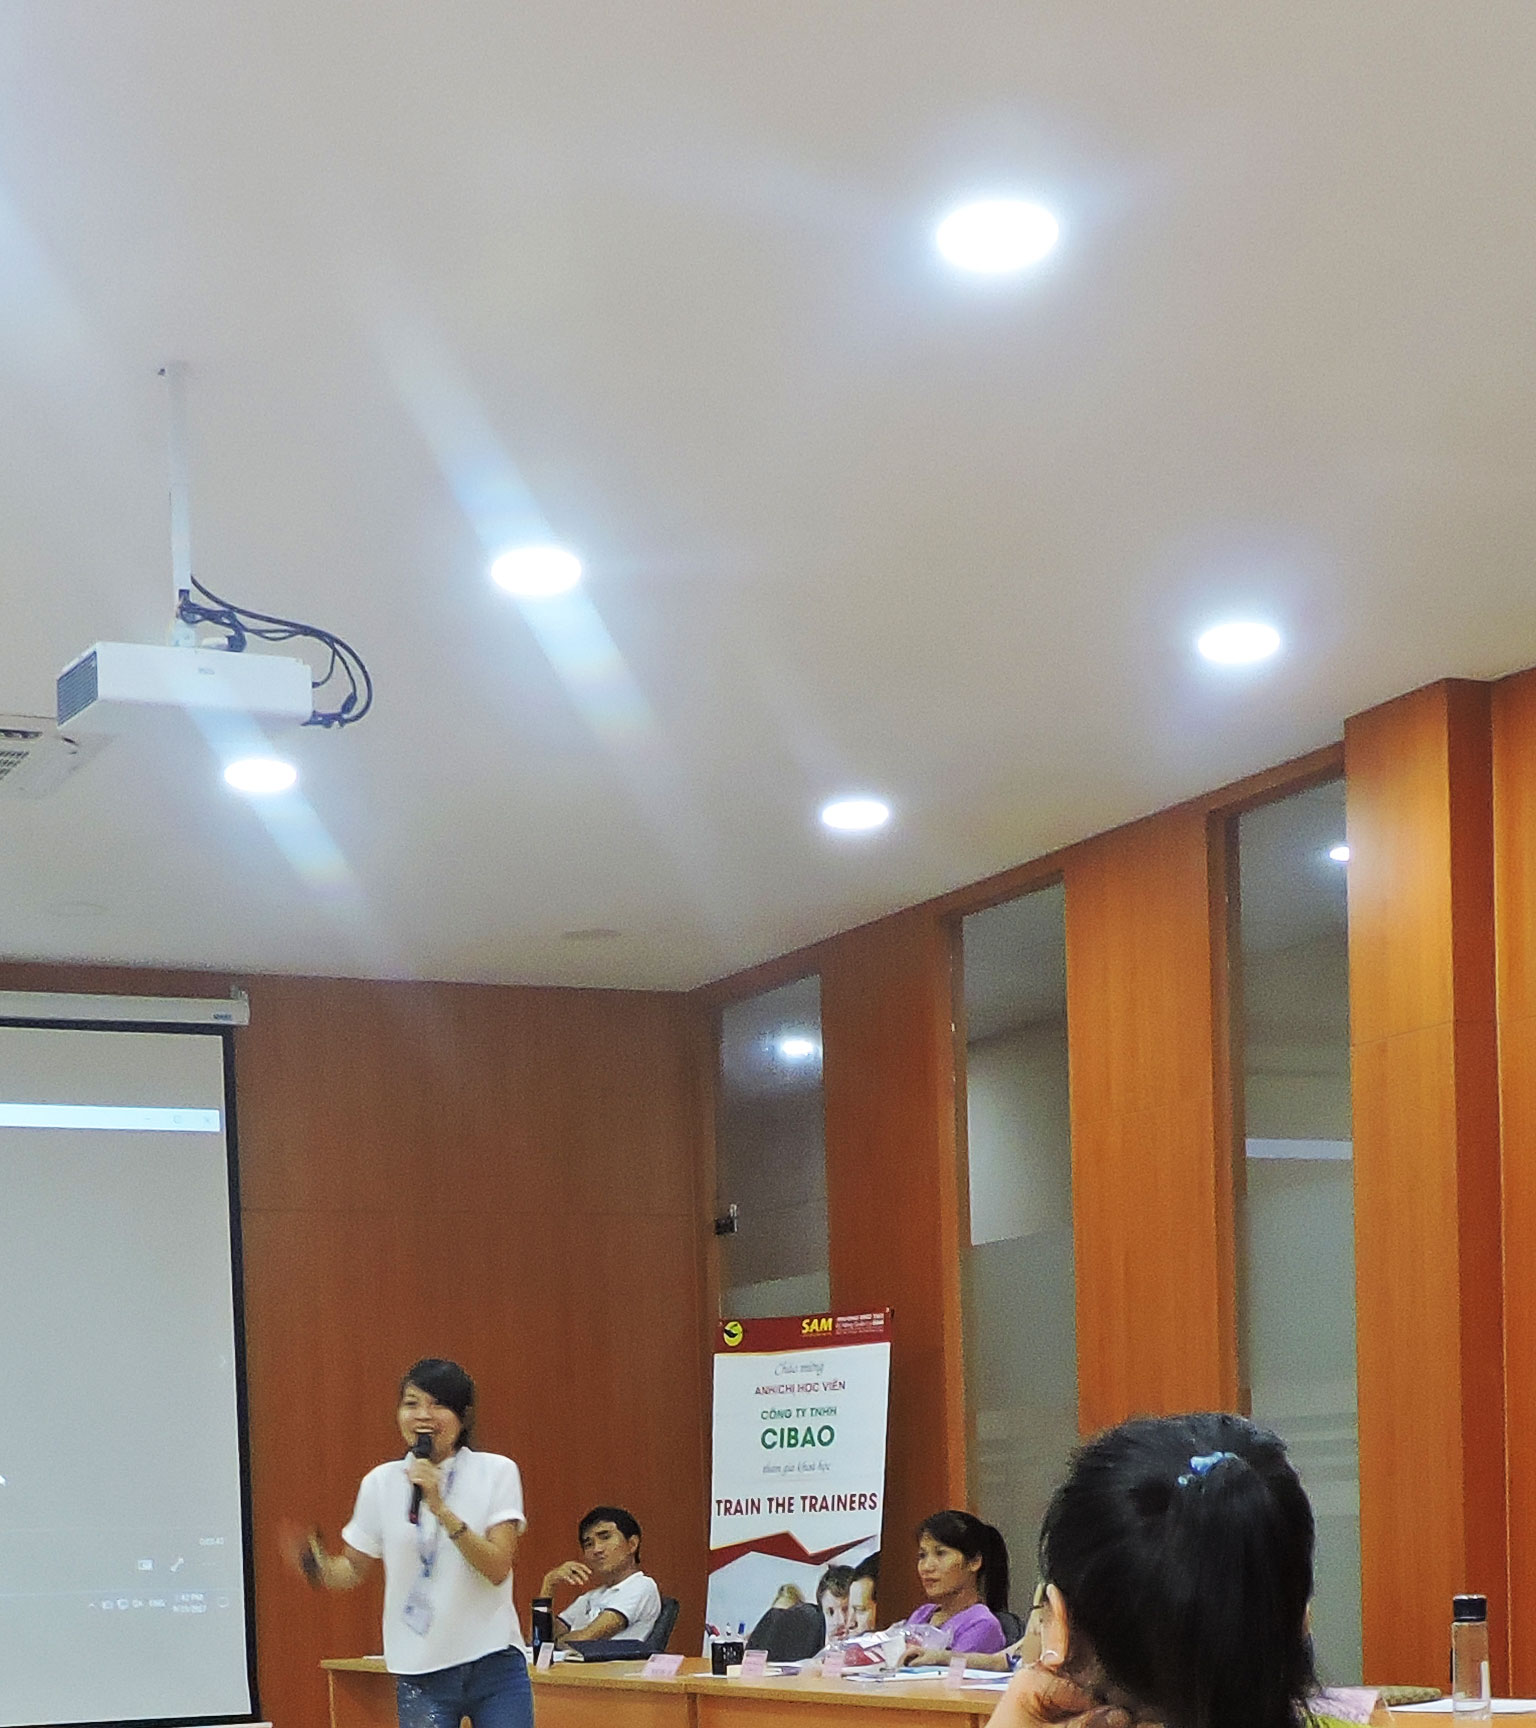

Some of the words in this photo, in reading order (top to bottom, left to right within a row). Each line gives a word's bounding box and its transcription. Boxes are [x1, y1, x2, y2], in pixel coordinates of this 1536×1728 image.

[801, 1317, 833, 1333] SAM
[796, 1407, 806, 1418] TY
[760, 1424, 835, 1450] CIBAO
[715, 1497, 761, 1517] TRAIN
[766, 1496, 795, 1515] THE
[800, 1492, 878, 1513] TRAINERS
